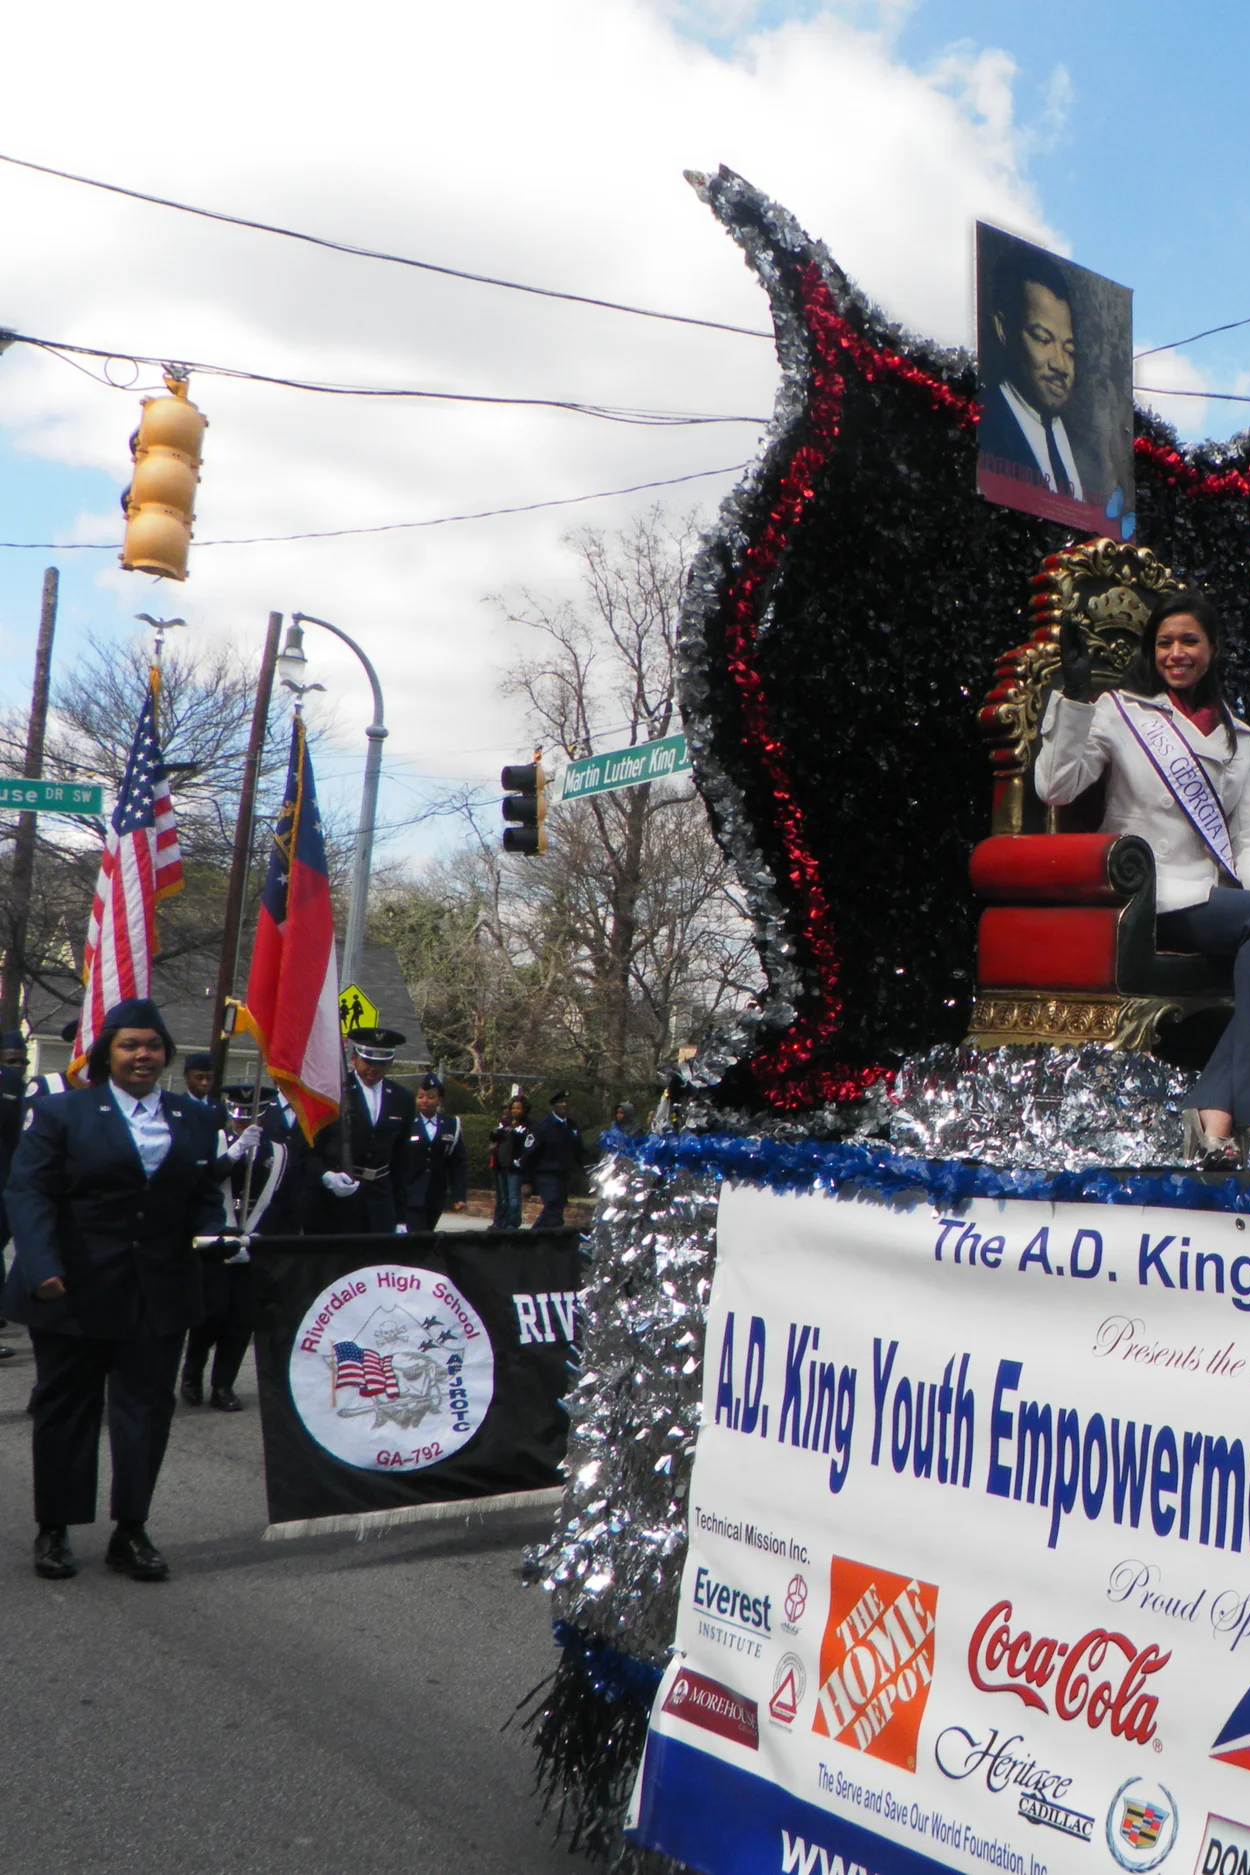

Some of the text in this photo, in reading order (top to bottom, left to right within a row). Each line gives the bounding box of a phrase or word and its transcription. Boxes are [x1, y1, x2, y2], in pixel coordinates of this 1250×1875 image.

[45, 787, 63, 800] DR
[72, 790, 92, 802] SW
[564, 739, 690, 794] Martin Luther King J
[1141, 719, 1174, 757] MISS
[1169, 757, 1223, 840] GEORGIA
[934, 1218, 1006, 1269] The
[1018, 1226, 1117, 1282] A.D.
[300, 1272, 481, 1354] Riverdale High School
[1092, 1315, 1203, 1372] Presents
[1206, 1341, 1246, 1378] the
[714, 1311, 769, 1438] A.D.
[778, 1322, 857, 1494] King
[871, 1337, 975, 1488] Youth
[376, 1442, 444, 1467] GA-792
[695, 1506, 811, 1565] Technical Mission Inc.
[693, 1566, 772, 1632] Everest
[836, 1583, 884, 1650] THE
[1107, 1559, 1207, 1623] Proud
[699, 1621, 763, 1659] INSTITUTE
[819, 1579, 936, 1740] HOME
[967, 1600, 1173, 1745] Coca-Cola
[853, 1649, 932, 1752] DEPOT
[935, 1726, 1073, 1801] Heritage
[818, 1762, 834, 1793] The
[835, 1770, 862, 1805] Serve
[864, 1788, 884, 1813] and
[884, 1791, 908, 1826] Save
[910, 1802, 929, 1835] Our
[931, 1810, 962, 1849] World
[1018, 1796, 1094, 1837] CADILLAC
